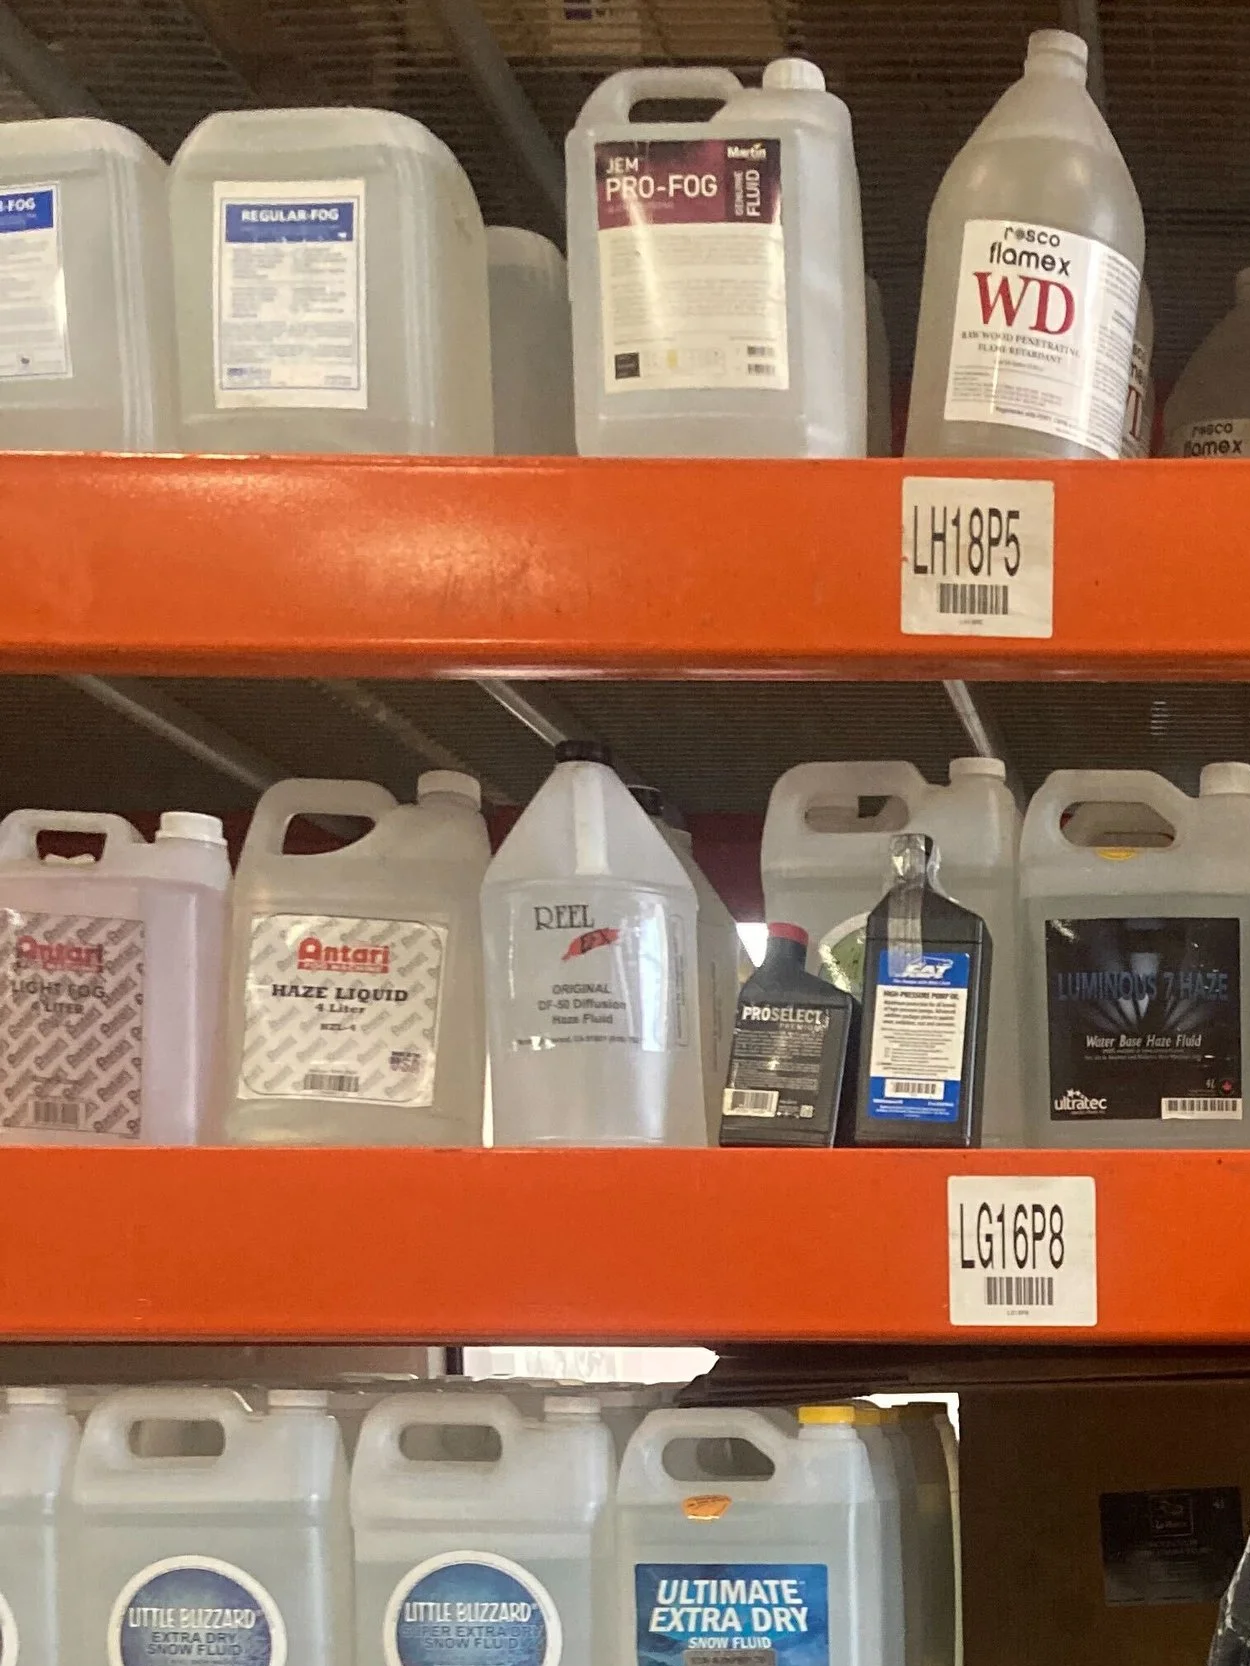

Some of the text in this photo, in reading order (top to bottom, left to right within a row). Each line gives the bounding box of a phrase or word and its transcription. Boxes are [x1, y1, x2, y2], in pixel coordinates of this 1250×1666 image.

[606, 156, 639, 175] JEM
[606, 173, 719, 202] PRO-FOG
[746, 169, 761, 217] FLUID
[1003, 225, 1061, 248] rosco
[989, 241, 1071, 277] flamex
[973, 271, 1077, 336] WD
[913, 505, 1021, 577] LH18P5
[533, 904, 596, 931] REEL
[298, 936, 390, 966] Antari
[271, 983, 409, 1002] HAZE LIQUID
[551, 983, 612, 995] ORIGINAL
[1057, 971, 1229, 999] LUMINOUS 7 HAZE
[314, 1003, 366, 1015] 4 Liter
[573, 999, 627, 1010] Diffusion
[582, 1013, 614, 1025] Fluid
[741, 1005, 823, 1025] PROSELECT
[1119, 1034, 1143, 1048] Base
[1146, 1034, 1173, 1048] Haze
[1175, 1033, 1203, 1048] Fluid
[1054, 1095, 1108, 1111] ultratec
[960, 1201, 1065, 1270] LG16P8
[656, 1579, 804, 1606] ULTIMATE
[128, 1607, 256, 1629] LITTLE BLIZZARD
[404, 1602, 534, 1623] LITTLE BLIZZARD
[648, 1606, 809, 1633] EXTRA DRY
[151, 1631, 238, 1644] EXTRA DRY
[454, 1625, 506, 1638] EXTRA
[147, 1643, 244, 1656] SNOW FLUID
[423, 1637, 520, 1650] SNOW FLUID
[687, 1636, 773, 1649] SNOW FLUID
